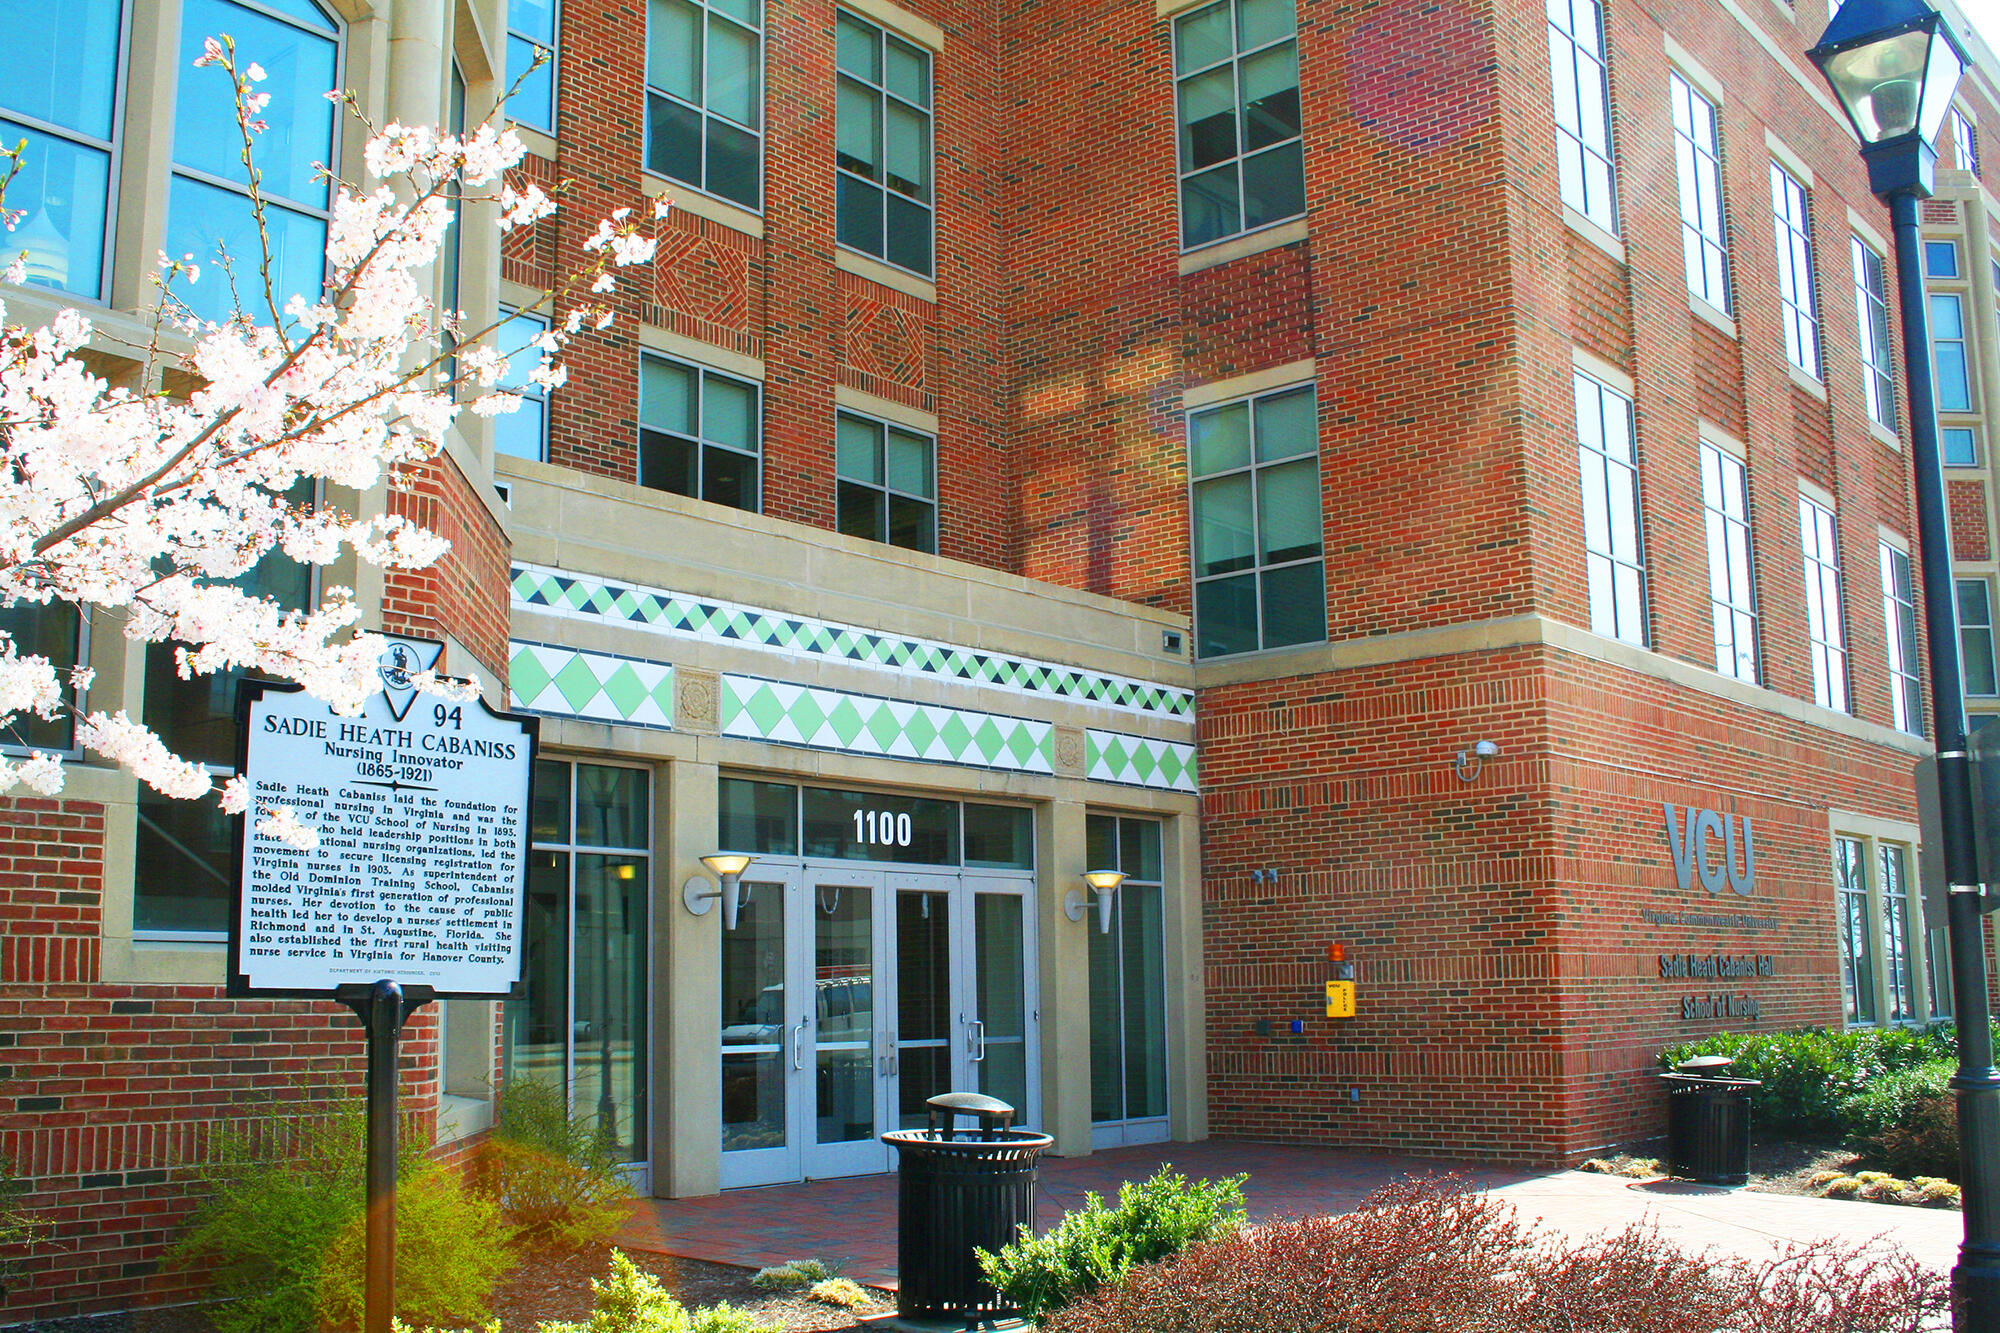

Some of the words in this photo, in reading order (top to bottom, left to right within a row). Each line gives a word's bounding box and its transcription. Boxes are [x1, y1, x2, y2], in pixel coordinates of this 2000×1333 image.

[434, 704, 462, 730] 94
[264, 714, 327, 738] SADIE
[340, 724, 412, 748] HEATH
[422, 734, 516, 760] CABANISS
[325, 742, 383, 763] Nursing
[393, 750, 464, 770] Innovator
[357, 762, 432, 781] (1865-1921)
[256, 780, 287, 792] Sadie
[297, 784, 329, 796] Heath
[340, 788, 386, 802] Cabaniss
[394, 794, 414, 804] laid
[421, 796, 437, 806] the
[444, 800, 496, 812] foundation
[504, 805, 518, 814] for
[256, 796, 324, 808] professional
[335, 802, 374, 813] nursing
[383, 806, 393, 814] in
[404, 807, 444, 819] Virginia
[453, 813, 470, 821] and
[502, 816, 517, 825] the
[306, 812, 318, 820] of
[324, 812, 340, 822] the
[349, 814, 370, 824] VCU
[375, 816, 409, 828] School
[416, 821, 427, 829] of
[433, 822, 470, 834] Nursing
[478, 826, 486, 834] in
[494, 827, 516, 837] 1893.
[854, 810, 911, 846] 1100
[315, 838, 356, 848] ational
[363, 841, 400, 853] nursing
[482, 850, 496, 858] led
[500, 852, 516, 860] the
[340, 826, 362, 836] held
[369, 828, 421, 841] leadership
[429, 835, 474, 845] positions
[479, 838, 488, 846] in
[494, 839, 516, 849] both
[253, 846, 310, 856] movement
[318, 850, 329, 858] to
[340, 852, 374, 861] secure
[382, 854, 426, 867] licensing
[434, 858, 492, 870] registration
[500, 863, 515, 872] for
[1663, 803, 1754, 897] VCU
[253, 857, 298, 872] Virginia
[307, 862, 342, 871] nurses
[350, 864, 360, 872] in
[368, 864, 392, 874] 1903.
[402, 868, 415, 876] As
[424, 870, 497, 882] superintendent
[252, 870, 271, 879] the
[280, 871, 300, 881] Old
[309, 873, 361, 885] Dominion
[372, 878, 415, 890] Training
[472, 884, 514, 894] Cabaniss
[251, 896, 292, 906] nurses.
[302, 898, 322, 907] Her
[330, 900, 376, 910] devotion
[385, 903, 396, 911] to
[404, 904, 421, 913] the
[484, 909, 513, 918] public
[252, 884, 291, 893] molded
[297, 885, 346, 897] Virginia's
[351, 888, 374, 898] first
[380, 892, 433, 902] generation
[438, 894, 449, 902] of
[455, 896, 513, 906] professional
[251, 908, 287, 918] health
[292, 910, 309, 919] led
[314, 911, 332, 920] her
[337, 913, 349, 921] to
[354, 913, 392, 925] develop
[446, 919, 498, 928] settlement
[503, 921, 512, 929] in
[1641, 908, 1677, 927] Virginia
[1680, 910, 1740, 928] Commonwealth
[1740, 915, 1778, 932] University
[250, 921, 306, 932] Richmond
[315, 924, 335, 933] and
[343, 925, 354, 934] in
[360, 925, 375, 935] St.
[495, 932, 512, 941] She
[250, 933, 272, 943] also
[278, 935, 341, 945] established
[350, 938, 368, 946] the
[374, 939, 399, 948] first
[404, 940, 429, 949] rural
[436, 941, 468, 951] health
[475, 943, 512, 954] visiting
[250, 948, 280, 956] nurse
[288, 948, 326, 958] service
[333, 949, 343, 958] in
[350, 949, 392, 961] Virginia
[400, 952, 415, 960] for
[422, 952, 463, 962] Hanover
[468, 954, 504, 964] County.
[1659, 954, 1688, 978] Sadie
[1688, 954, 1716, 976] Heath
[1718, 955, 1756, 977] Cabaniss
[1757, 954, 1774, 976] Hall
[1682, 996, 1713, 1019] School
[1715, 996, 1725, 1018] of
[1726, 994, 1760, 1020] Nursing
